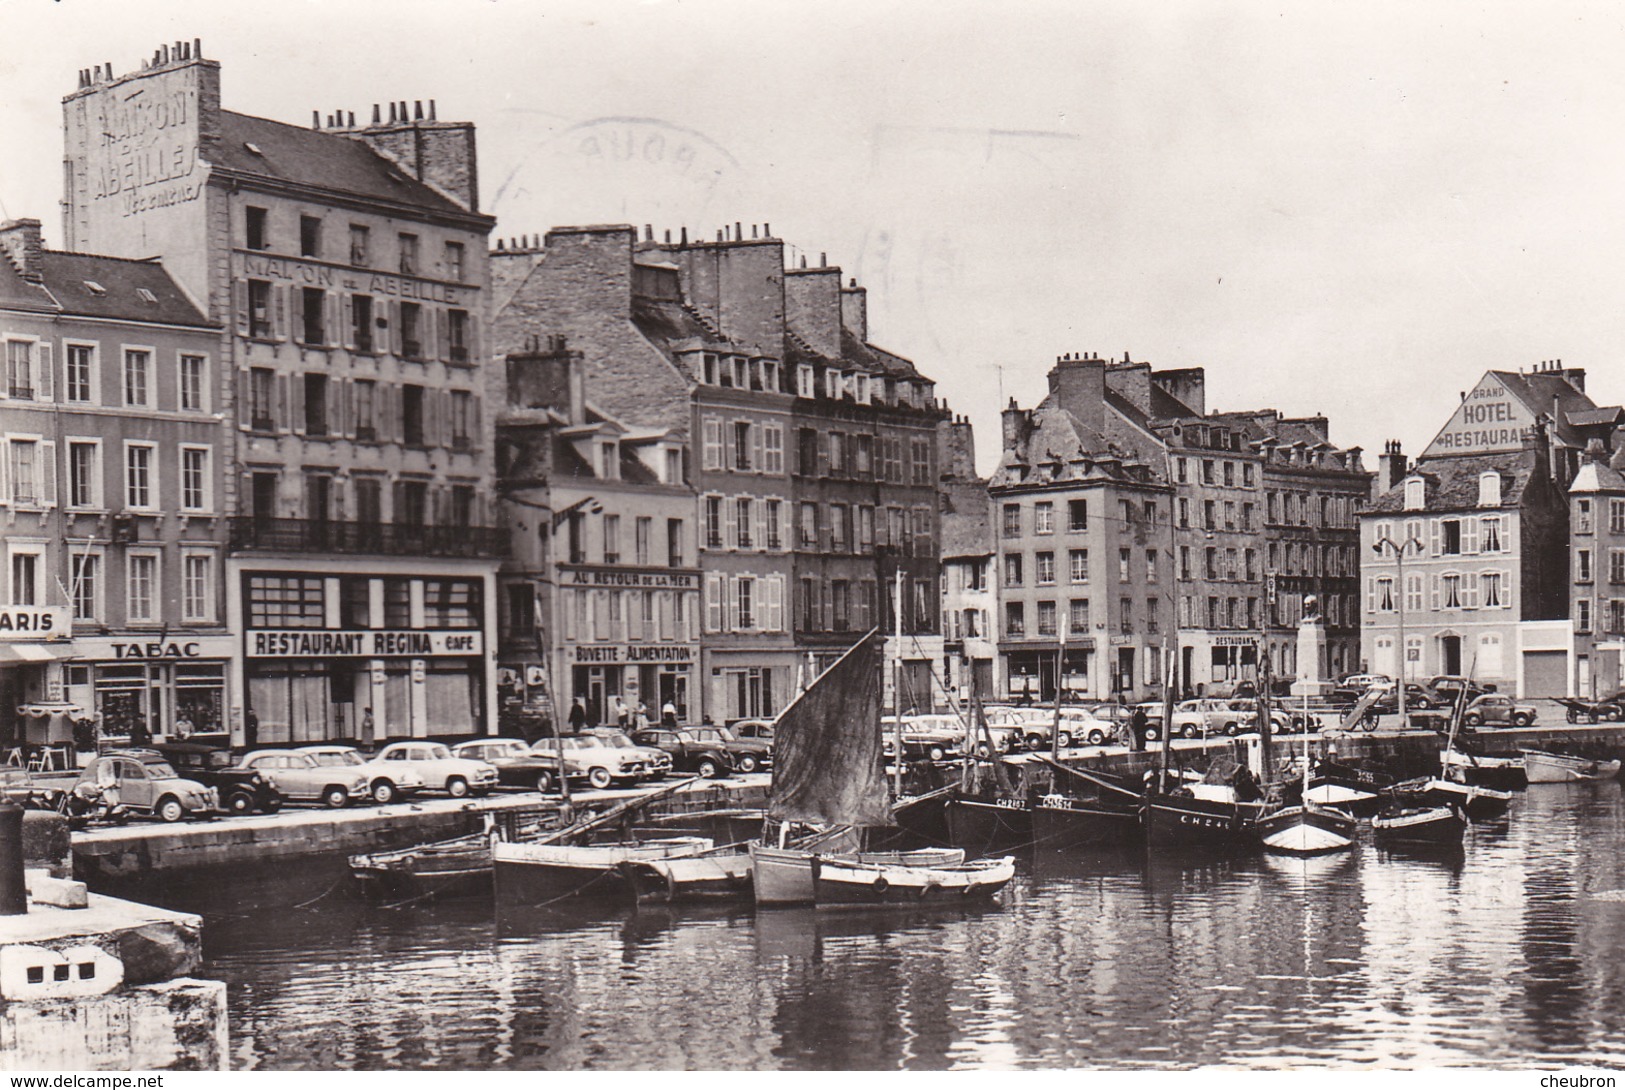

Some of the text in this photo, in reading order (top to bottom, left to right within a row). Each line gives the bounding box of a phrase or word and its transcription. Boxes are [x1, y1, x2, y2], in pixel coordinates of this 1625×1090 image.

[94, 145, 199, 200] ABEILLES
[1473, 387, 1505, 399] GRAND
[1464, 402, 1516, 424] HOTEL
[573, 571, 691, 587] AU RETOUR DE LA MER
[111, 642, 200, 658] TABAC
[256, 632, 364, 654] RESTAURANT
[374, 633, 432, 654] REGINA
[576, 646, 690, 661] BUVETTE ALIMENTATION
